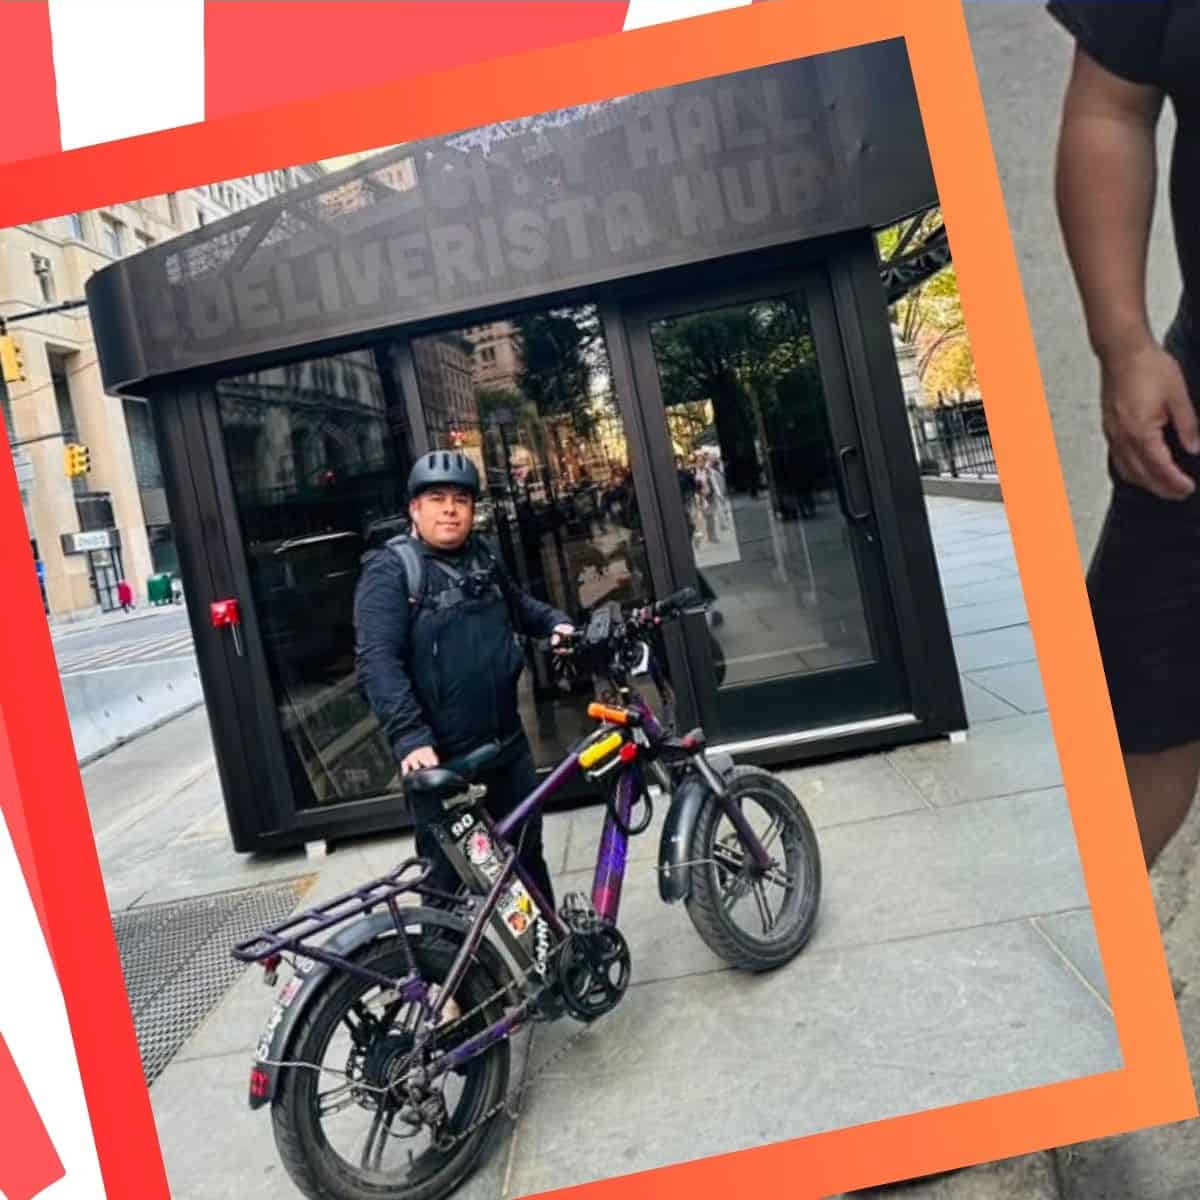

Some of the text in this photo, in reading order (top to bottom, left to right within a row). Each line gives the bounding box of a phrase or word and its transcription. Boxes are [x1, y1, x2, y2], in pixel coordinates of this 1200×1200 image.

[626, 78, 809, 168] HALL
[187, 151, 827, 341] DELIVERISTA HUB
